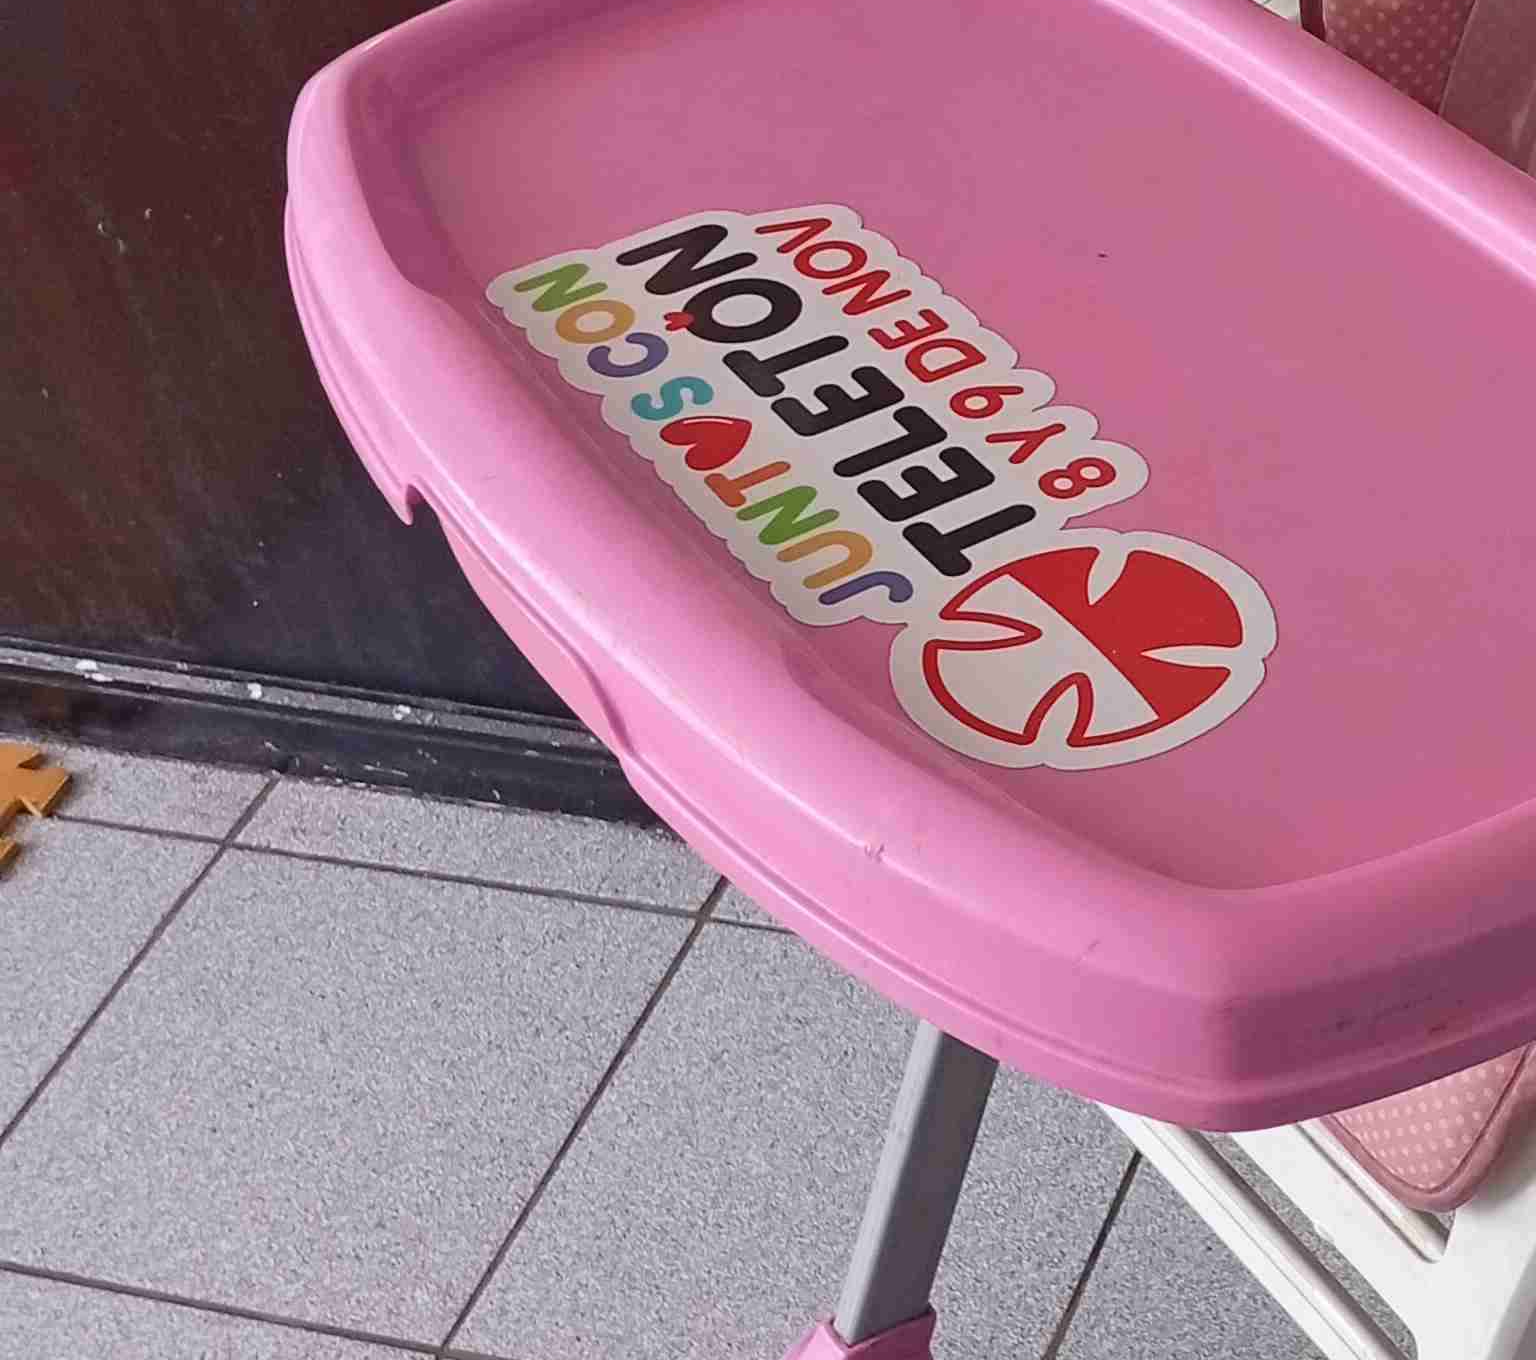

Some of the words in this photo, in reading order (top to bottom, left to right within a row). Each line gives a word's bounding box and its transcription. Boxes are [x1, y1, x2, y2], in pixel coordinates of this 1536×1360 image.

[755, 217, 911, 315] NOV
[514, 263, 668, 377] CON
[867, 308, 986, 383] DE
[949, 385, 1024, 419] 9
[986, 423, 1066, 465] Y
[1038, 456, 1115, 500] 8
